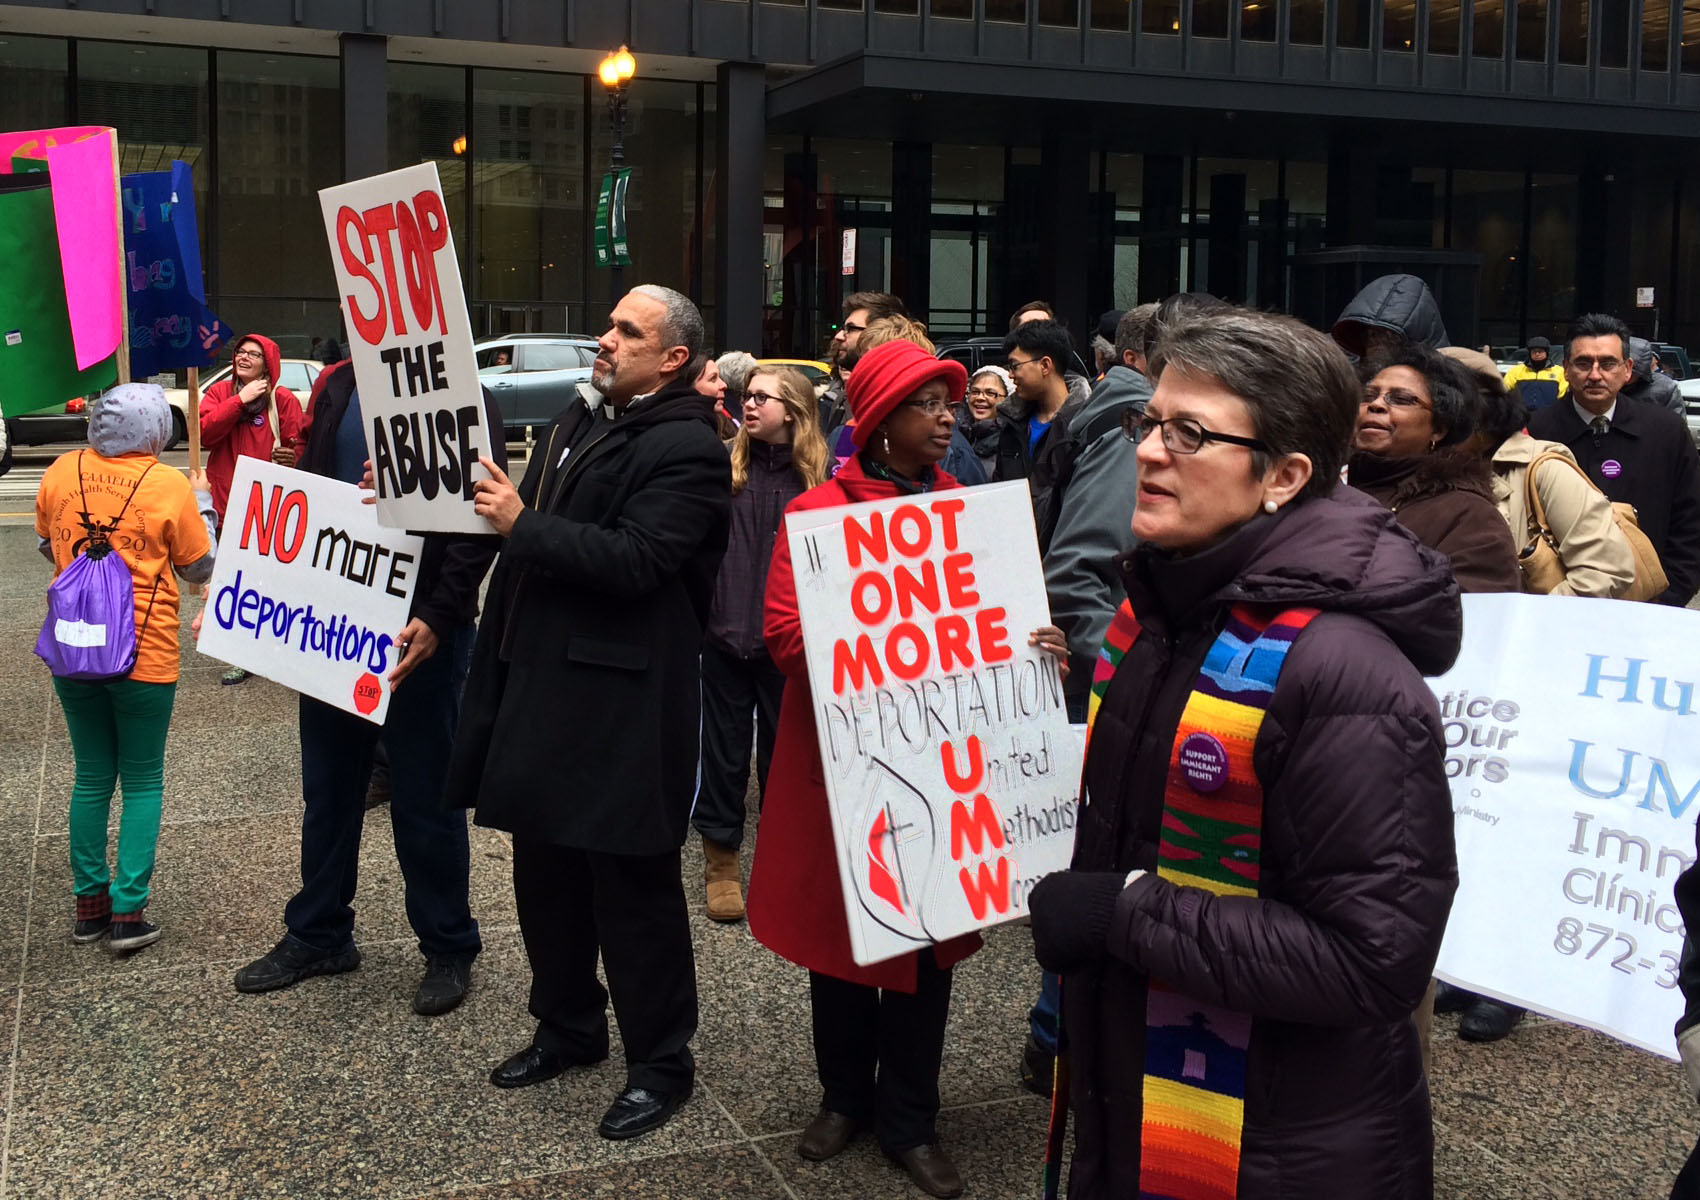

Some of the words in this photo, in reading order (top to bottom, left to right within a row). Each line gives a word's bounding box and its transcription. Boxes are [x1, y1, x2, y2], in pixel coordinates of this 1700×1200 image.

[336, 190, 449, 346] STOP
[380, 340, 449, 397] THE
[373, 405, 479, 501] ABUSE
[56, 498, 70, 521] Youth
[56, 527, 71, 542] 20
[120, 535, 146, 551] 20
[239, 481, 308, 564] NO
[843, 498, 965, 568] NOT
[850, 551, 980, 626] ONE
[214, 570, 394, 674] deportations
[832, 606, 1013, 696] MORE
[357, 684, 379, 697] STOP
[823, 655, 1062, 772] DEPORTATION
[1577, 653, 1698, 716] Hu
[1185, 749, 1217, 763] SUPPORT
[1443, 717, 1519, 750] Our
[1180, 758, 1222, 774] IMMIGRANT
[1188, 769, 1213, 782] RIGHTS
